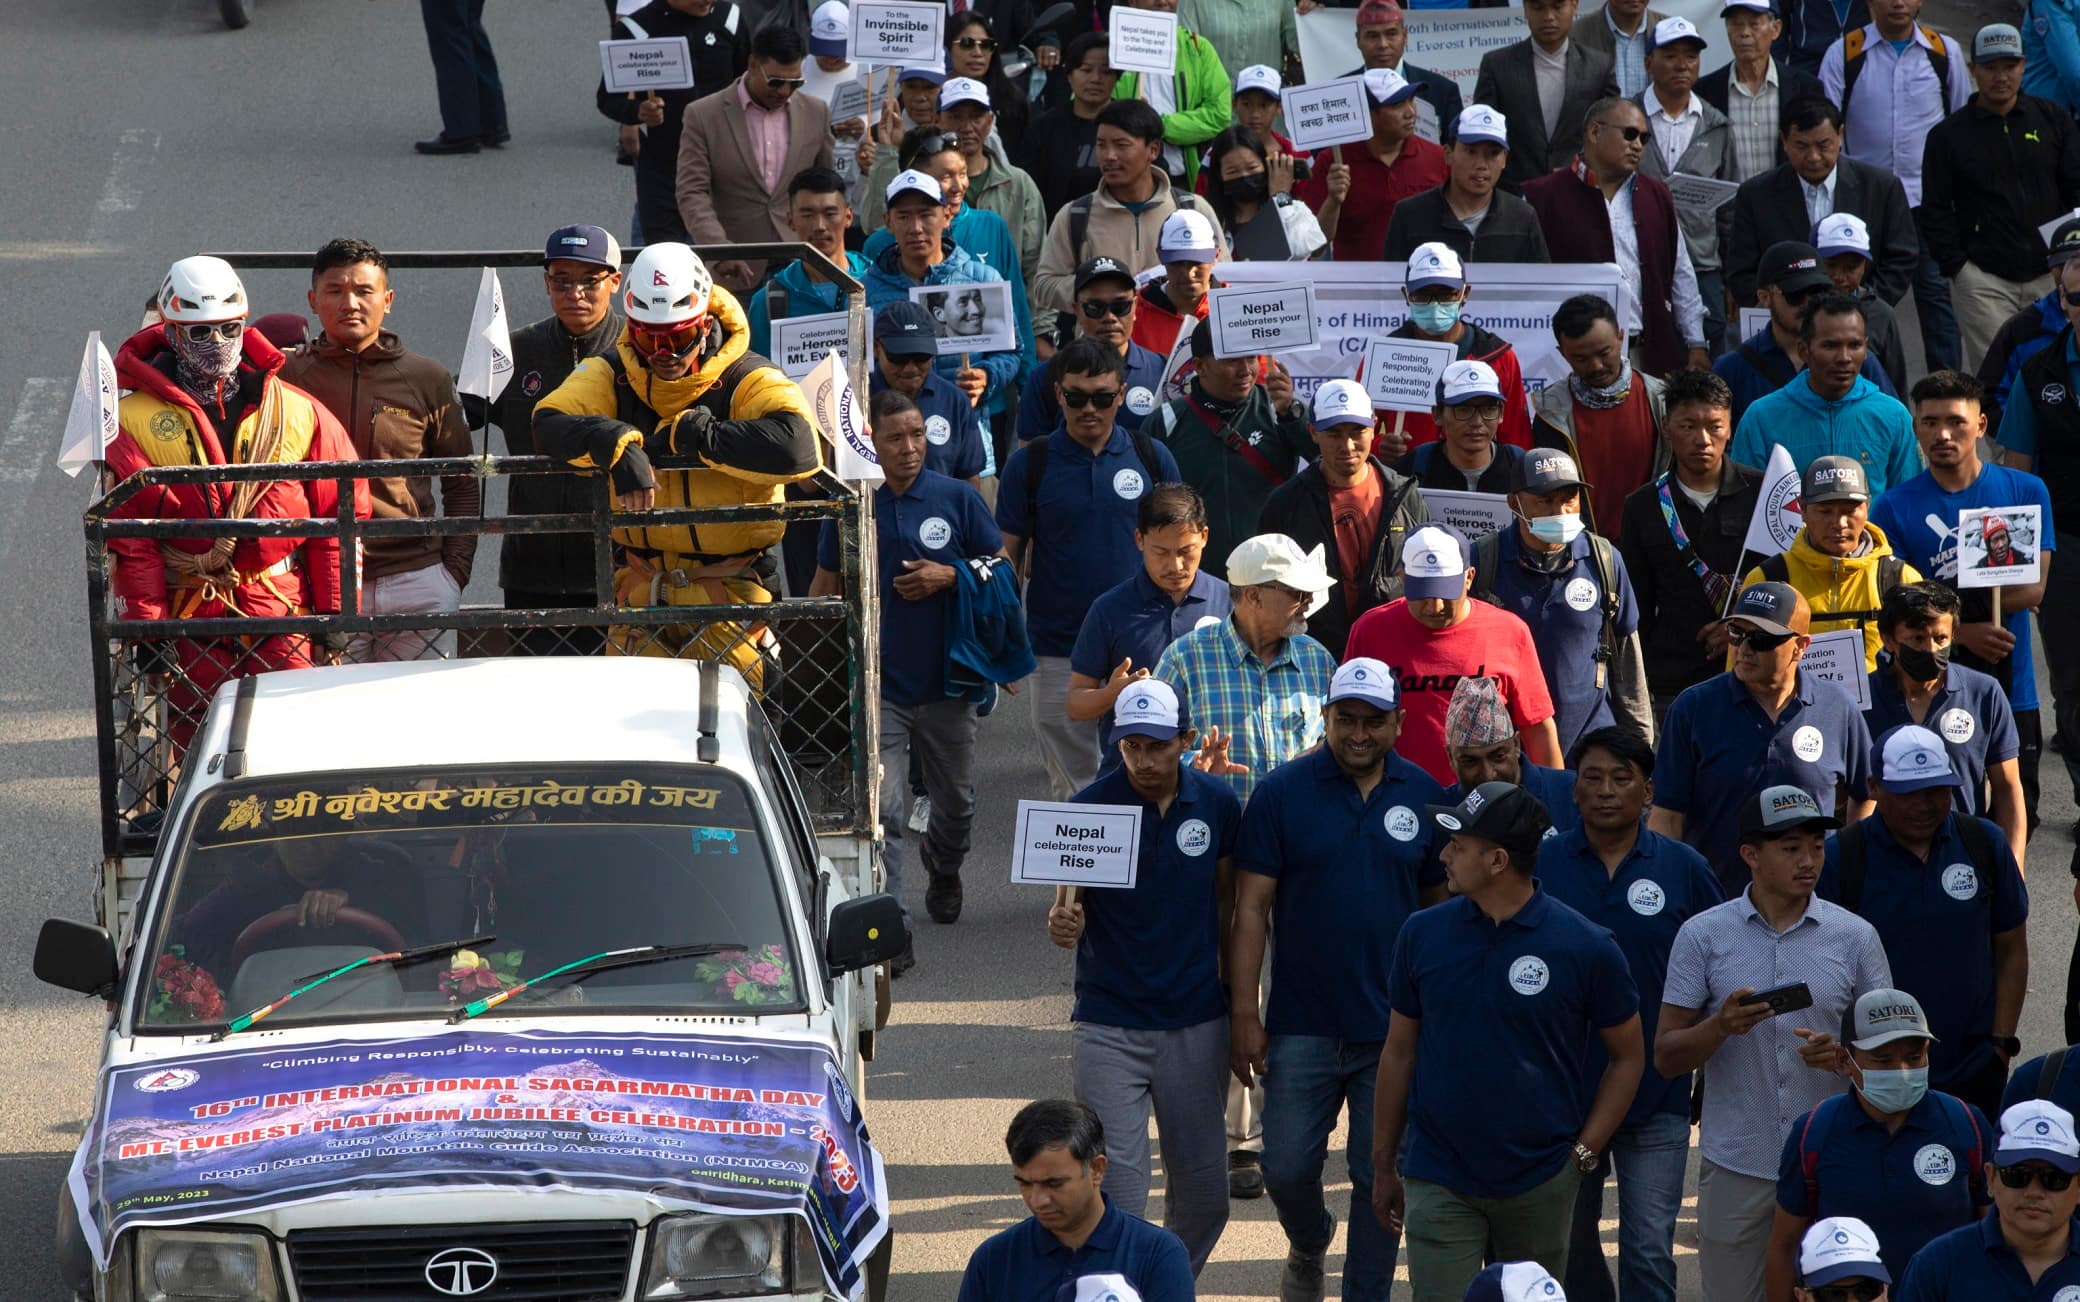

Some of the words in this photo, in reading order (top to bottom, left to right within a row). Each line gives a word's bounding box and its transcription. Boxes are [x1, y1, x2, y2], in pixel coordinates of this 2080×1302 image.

[886, 11, 895, 19] To
[896, 11, 910, 19] the
[865, 18, 929, 32] Invinsible
[878, 32, 914, 45] Spirit
[629, 49, 664, 61] Nepal
[881, 45, 891, 54] of
[892, 45, 909, 53] Man
[637, 69, 661, 78] Rise
[1242, 300, 1285, 317] Nepal
[1228, 317, 1279, 329] celebrates
[1280, 314, 1302, 325] your
[1328, 313, 1348, 327] of
[800, 328, 847, 340] Celebrating
[1251, 326, 1281, 340] Rise
[787, 345, 801, 353] the
[802, 337, 848, 351] Heroes
[787, 354, 808, 365] Mt.
[1391, 352, 1429, 365] Climbing
[1382, 361, 1434, 376] Responsibly,
[1382, 375, 1431, 389] Celebrating
[1381, 385, 1430, 399] Sustainably
[852, 436, 878, 464] NEPAL
[1769, 471, 1800, 517] MOUNTAINEE
[1443, 507, 1493, 519] Celebrating
[1446, 516, 1496, 530] Heroes
[1770, 518, 1788, 543] NEPAL
[272, 791, 321, 821] श्री
[460, 779, 590, 810] महादेव
[591, 779, 647, 807] की
[650, 786, 721, 809] जय
[1055, 824, 1105, 841] Nepal
[1034, 841, 1095, 853] celebrates
[1096, 845, 1123, 856] your
[1060, 855, 1095, 869] Rise
[1868, 1005, 1916, 1021] SATORI
[368, 1045, 498, 1061] Responsibly,
[504, 1047, 625, 1056] Celebrating
[263, 1077, 521, 1109] INTERNATIONAL
[527, 1077, 760, 1104] SAGARMATHA
[760, 1089, 826, 1108] DAY
[496, 1094, 519, 1105] &
[118, 1141, 172, 1160] MT.
[176, 1123, 305, 1152] EVEREST
[311, 1108, 463, 1133] PLATINUM
[467, 1107, 582, 1123] JUBILEE
[588, 1108, 786, 1137] CELEBRATION
[200, 1163, 267, 1181] Nepal
[274, 1148, 370, 1171] National
[376, 1140, 485, 1157] Mountain
[488, 1142, 559, 1153] Guide
[561, 1143, 698, 1163] Association
[703, 1155, 810, 1174] (NNMGA)
[143, 1195, 174, 1205] May,
[177, 1190, 210, 1199] 2023
